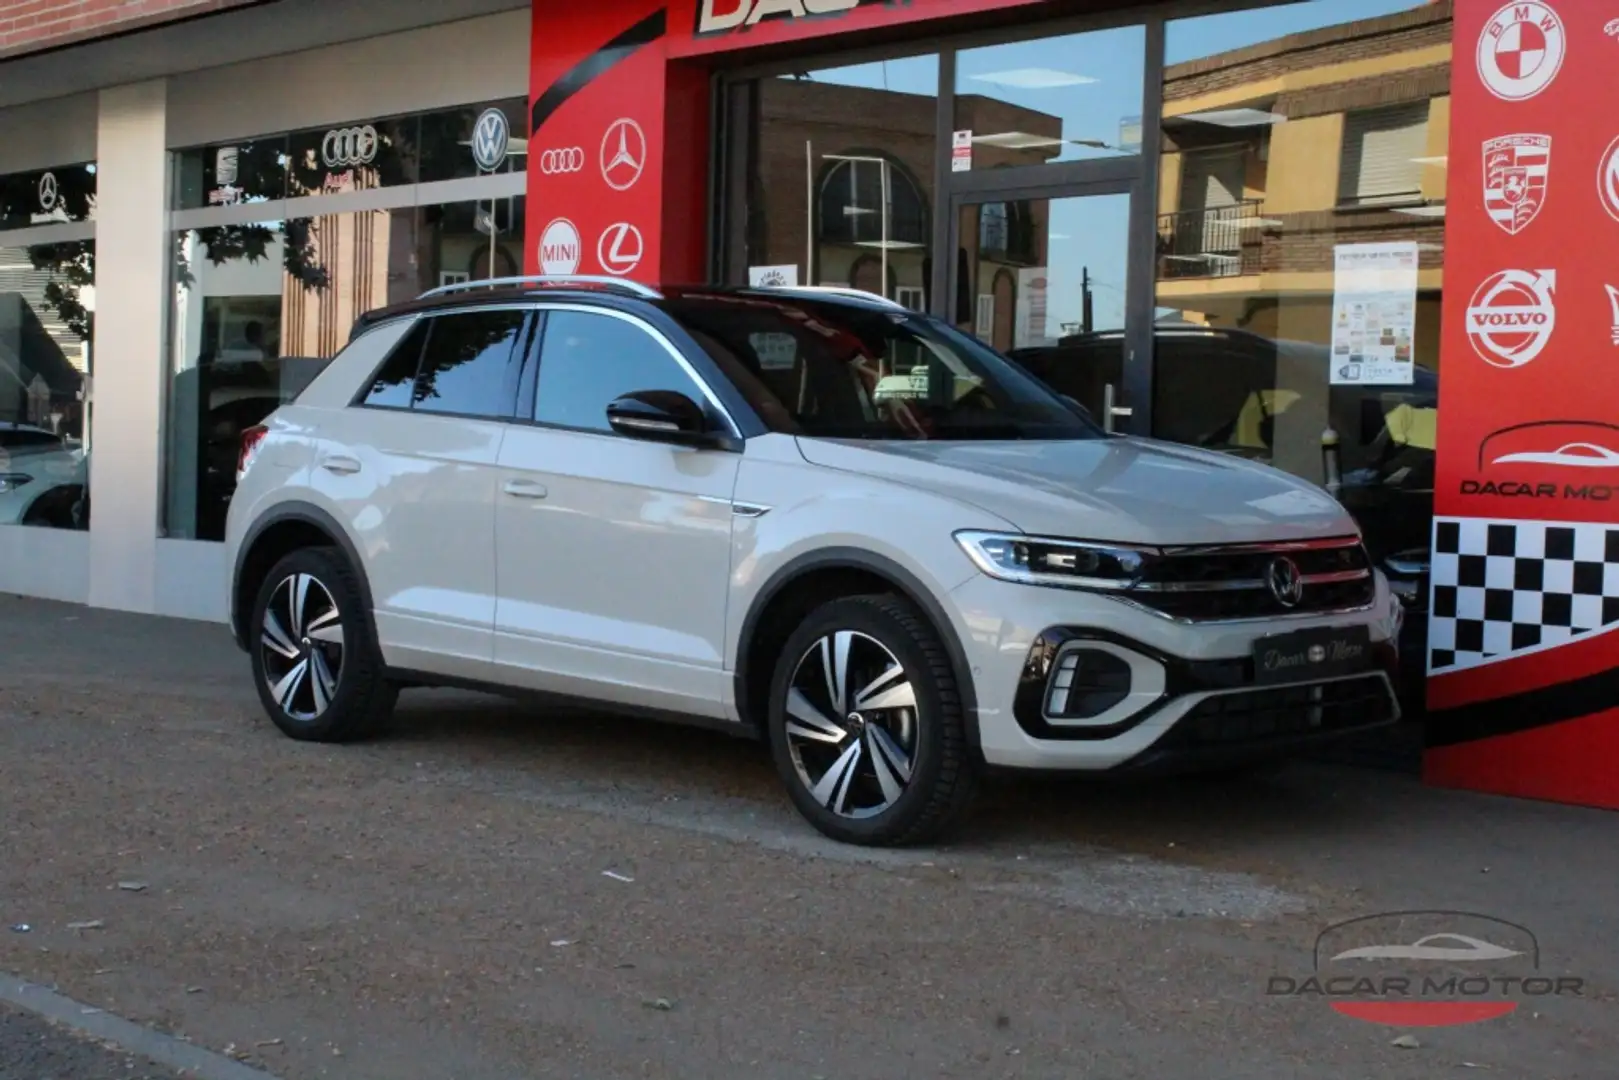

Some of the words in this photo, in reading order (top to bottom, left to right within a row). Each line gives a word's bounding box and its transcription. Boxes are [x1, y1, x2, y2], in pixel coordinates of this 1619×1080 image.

[1489, 6, 1556, 39] BMW
[543, 243, 576, 262] MINI
[1472, 312, 1547, 326] VOLVO
[1460, 480, 1557, 498] DACAR
